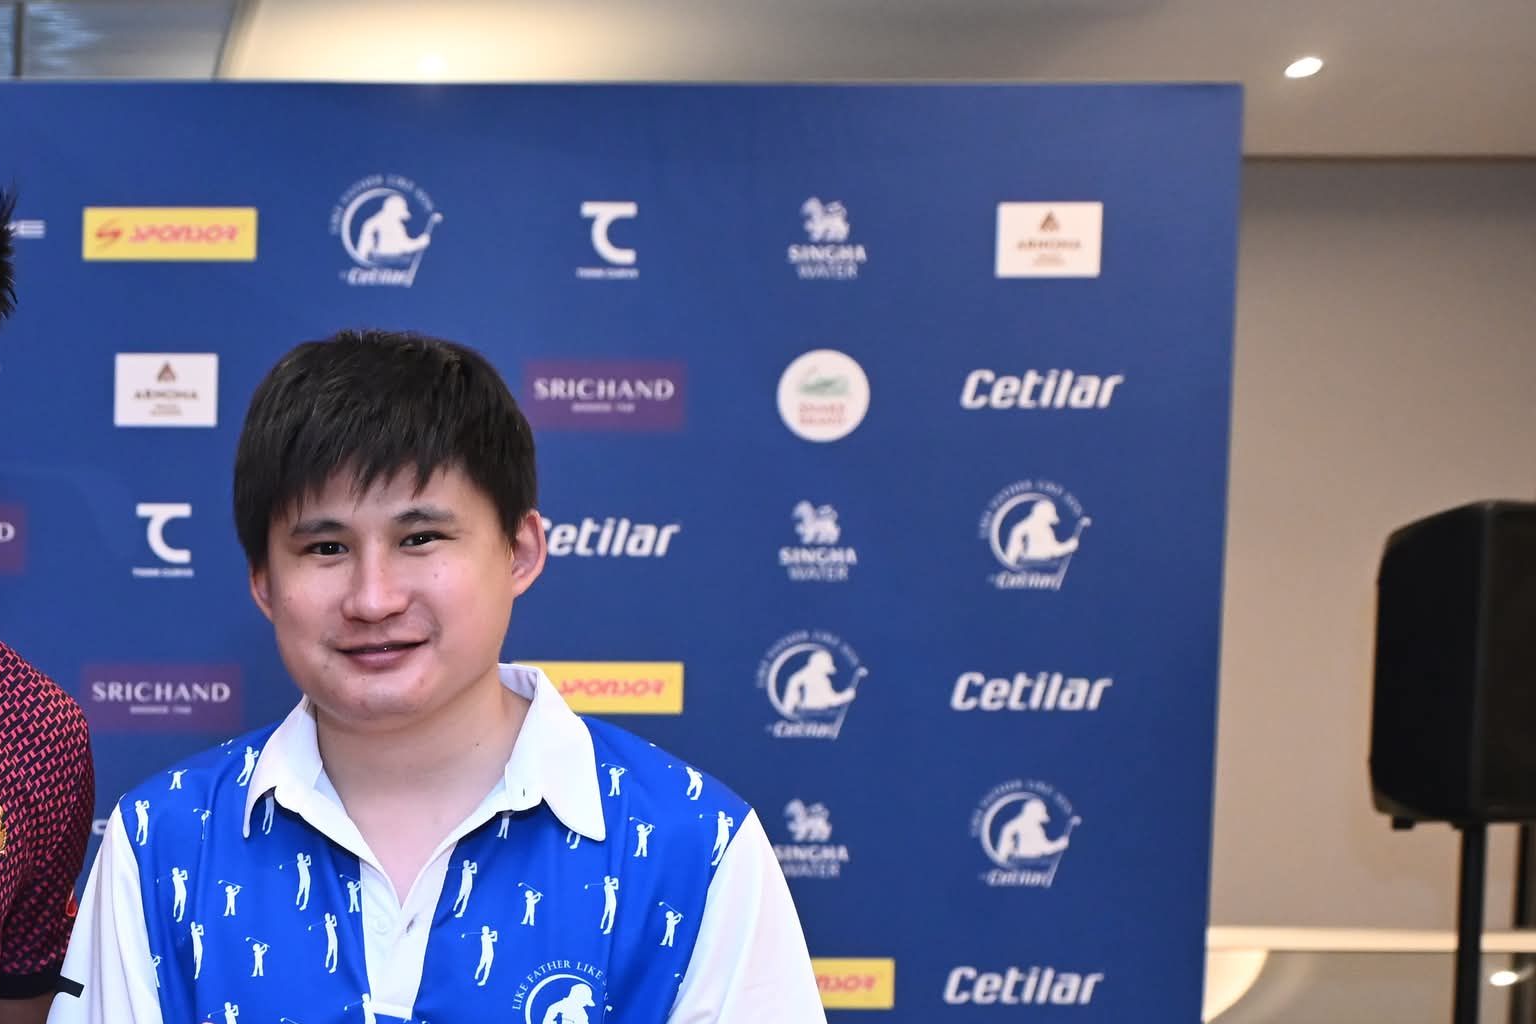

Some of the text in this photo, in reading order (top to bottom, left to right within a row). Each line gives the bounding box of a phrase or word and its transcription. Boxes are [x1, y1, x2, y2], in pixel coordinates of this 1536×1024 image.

[532, 378, 676, 401] SRICHAND
[960, 368, 1124, 409] Cetilar
[91, 681, 232, 702] SRICHAND
[949, 671, 1113, 711] Cetilar
[512, 960, 604, 1010] LIKE FATHER LIKE
[942, 966, 1105, 1006] Cetilar
